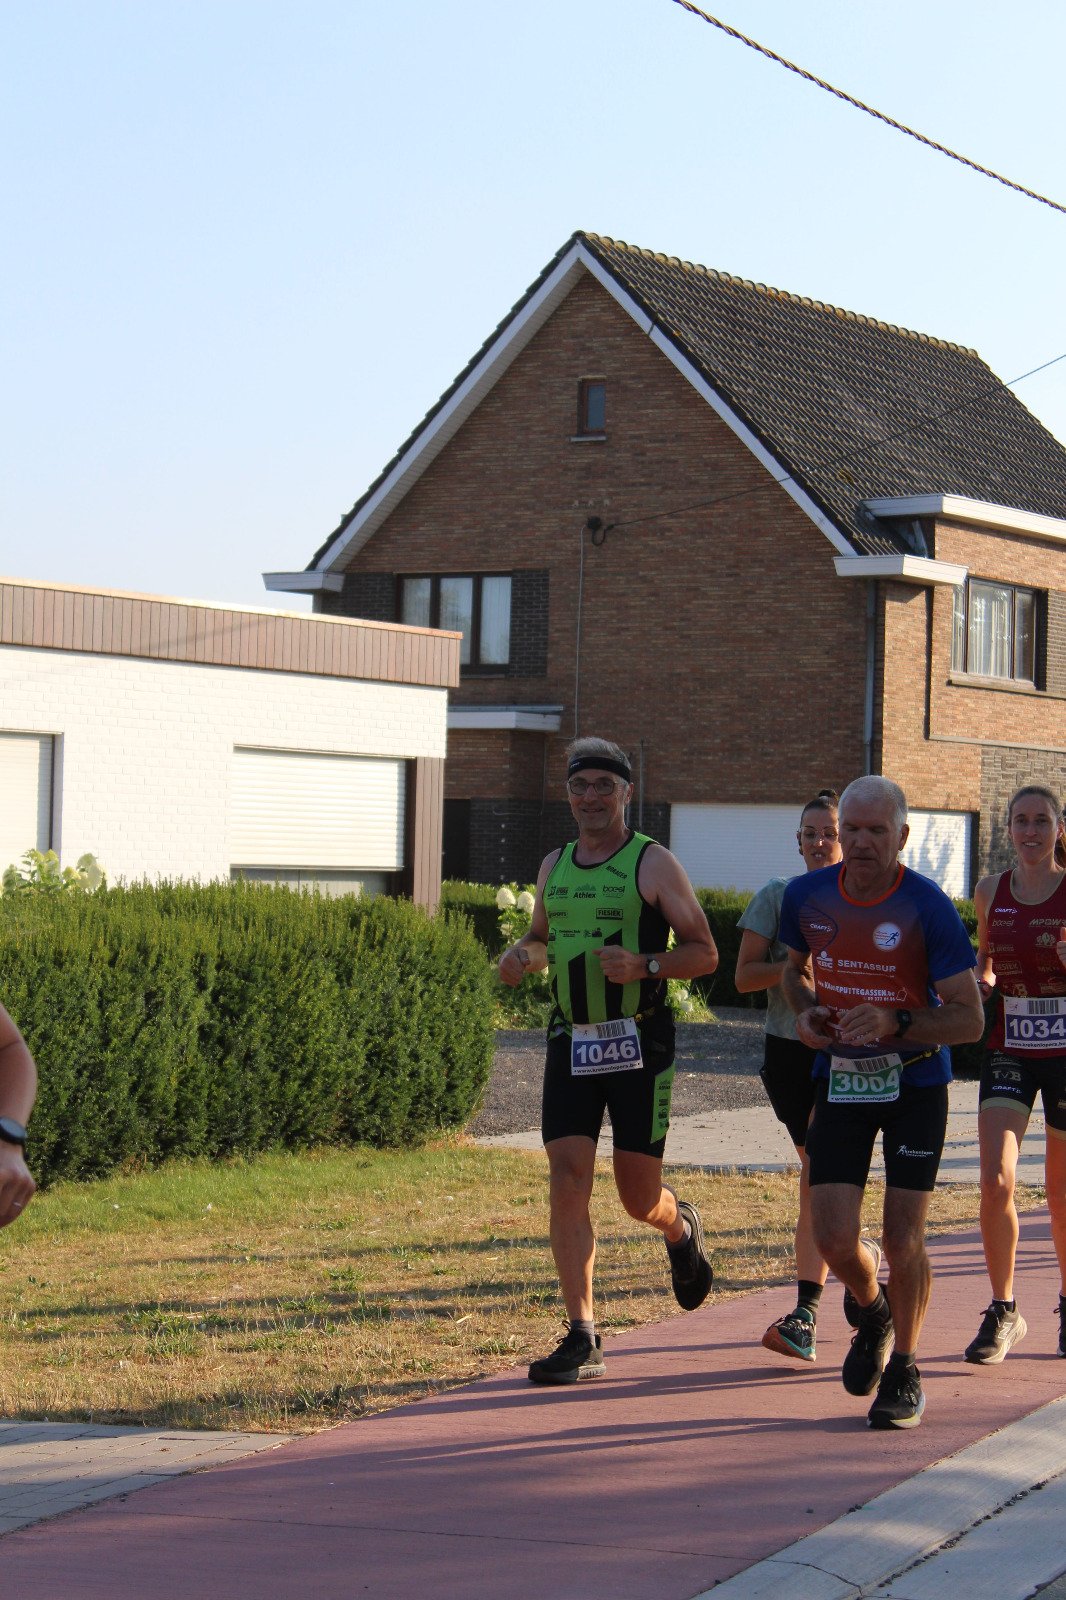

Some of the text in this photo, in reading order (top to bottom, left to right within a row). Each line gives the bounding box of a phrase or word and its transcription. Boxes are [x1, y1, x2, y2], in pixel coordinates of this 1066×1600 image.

[837, 959, 896, 972] SENTASSUR
[1009, 1018, 1066, 1039] 1034
[576, 1040, 636, 1064] 1046
[834, 1068, 900, 1093] 3004
